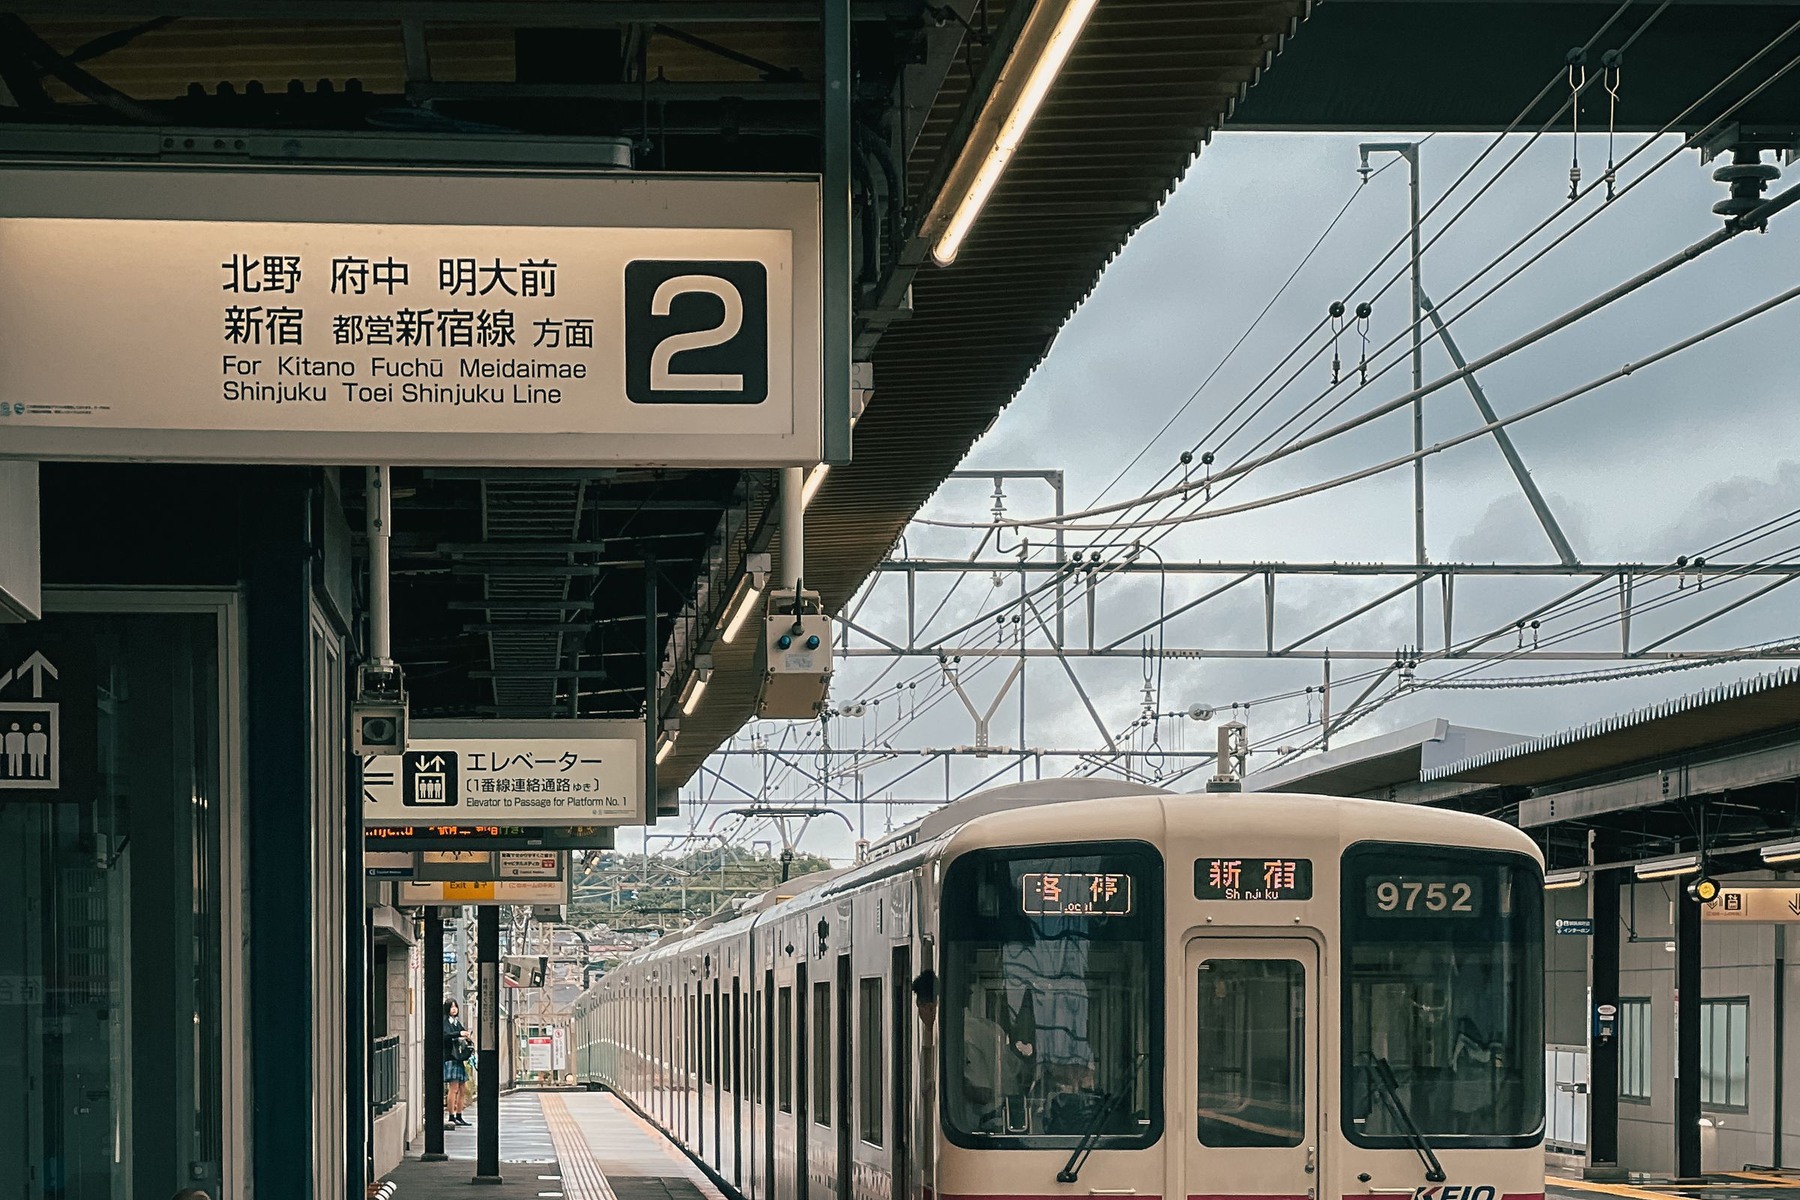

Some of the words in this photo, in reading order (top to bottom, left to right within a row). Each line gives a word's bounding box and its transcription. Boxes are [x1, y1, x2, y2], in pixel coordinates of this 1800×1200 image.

[222, 253, 302, 294] 北野
[331, 255, 409, 296] 府中
[439, 257, 557, 298] 明大前
[225, 304, 304, 346] 新宿
[333, 307, 516, 348] 都営新宿線
[533, 317, 594, 348] 方面
[649, 274, 745, 393] 2
[222, 355, 262, 376] For
[278, 356, 355, 377] Kitano
[371, 357, 444, 378] Fuchū
[460, 358, 587, 379] Meidaimae
[223, 380, 327, 404] Shinjuku
[342, 382, 393, 403] Toei
[402, 382, 504, 406] Shinjuku
[513, 384, 562, 404] Line
[466, 751, 602, 773] エレベーター
[466, 796, 501, 807] Elevator
[503, 797, 513, 807] to
[514, 797, 551, 808] Passage
[553, 796, 564, 807] for
[567, 796, 604, 807] Platform
[605, 797, 620, 807] No.
[622, 796, 628, 807] 1
[1209, 859, 1296, 889] 新宿
[1225, 888, 1279, 900] Shnjku
[1376, 881, 1473, 912] 9752
